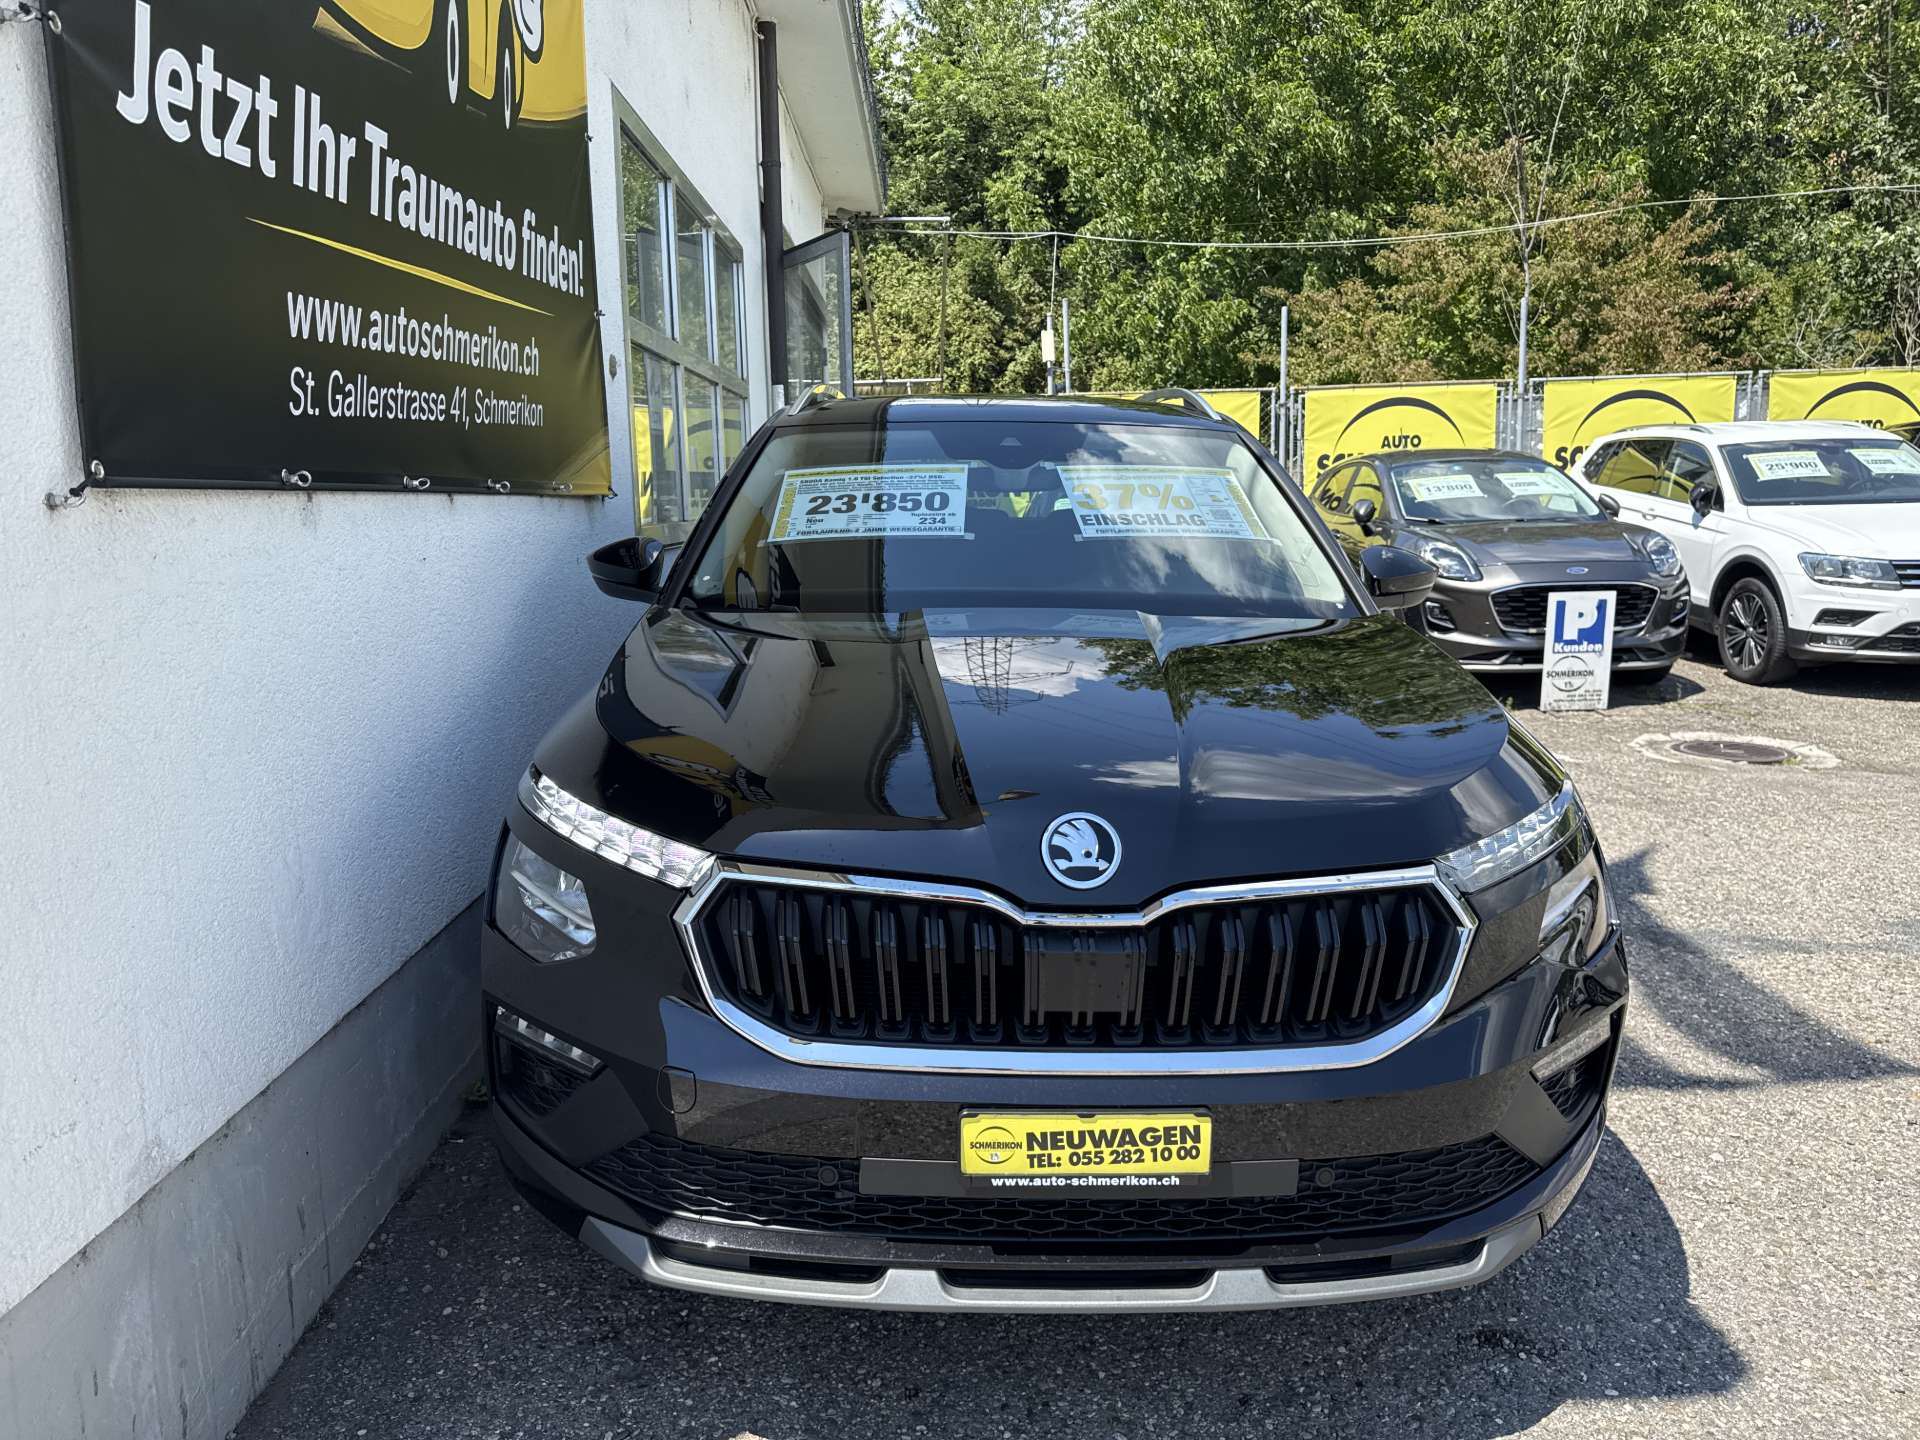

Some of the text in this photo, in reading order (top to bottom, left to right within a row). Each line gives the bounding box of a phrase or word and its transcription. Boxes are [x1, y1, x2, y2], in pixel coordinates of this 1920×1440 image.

[116, 0, 585, 298] Jetzt Ihr Traumauto finden!
[287, 291, 540, 376] www.autoschmerikon.ch
[290, 366, 544, 430] St. Gallerstrasse 41, Schmerikon
[1381, 434, 1422, 449] AUTO
[805, 491, 950, 516] 23'850
[1072, 483, 1195, 510] 37%
[918, 517, 947, 525] 234
[1080, 513, 1207, 527] EINSCHLAG
[1553, 641, 1604, 653] Kunden
[1546, 669, 1594, 679] SCHMERIKON
[970, 1141, 1022, 1150] SCHMERIKON
[1026, 1125, 1201, 1151] NEUWAGEN
[1027, 1145, 1201, 1168] TEL: 055 282 10 00
[991, 1175, 1180, 1187] www.auto-schmerikon.ch
